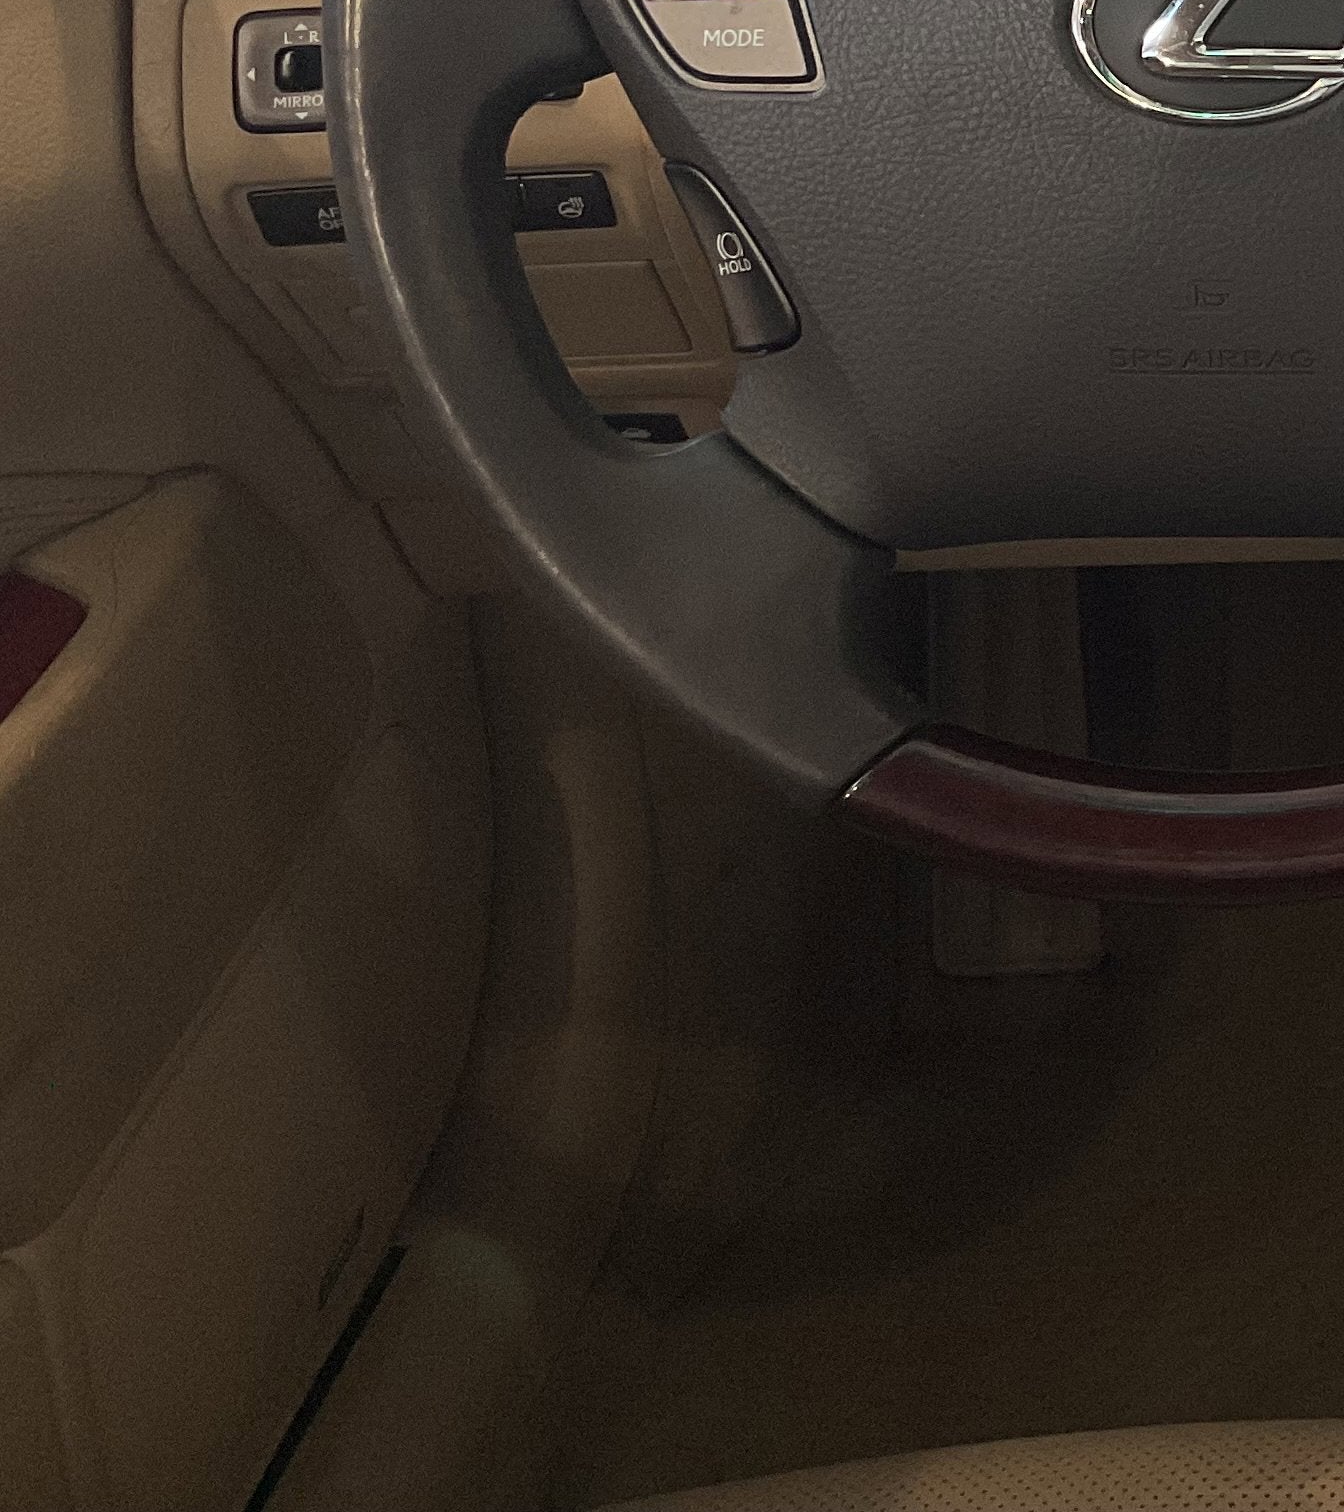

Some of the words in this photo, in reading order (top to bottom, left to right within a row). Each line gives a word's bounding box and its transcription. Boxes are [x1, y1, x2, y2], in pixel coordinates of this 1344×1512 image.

[284, 31, 293, 45] L
[702, 28, 766, 48] MODE
[273, 94, 324, 109] MIRRO
[718, 257, 752, 276] HOLD
